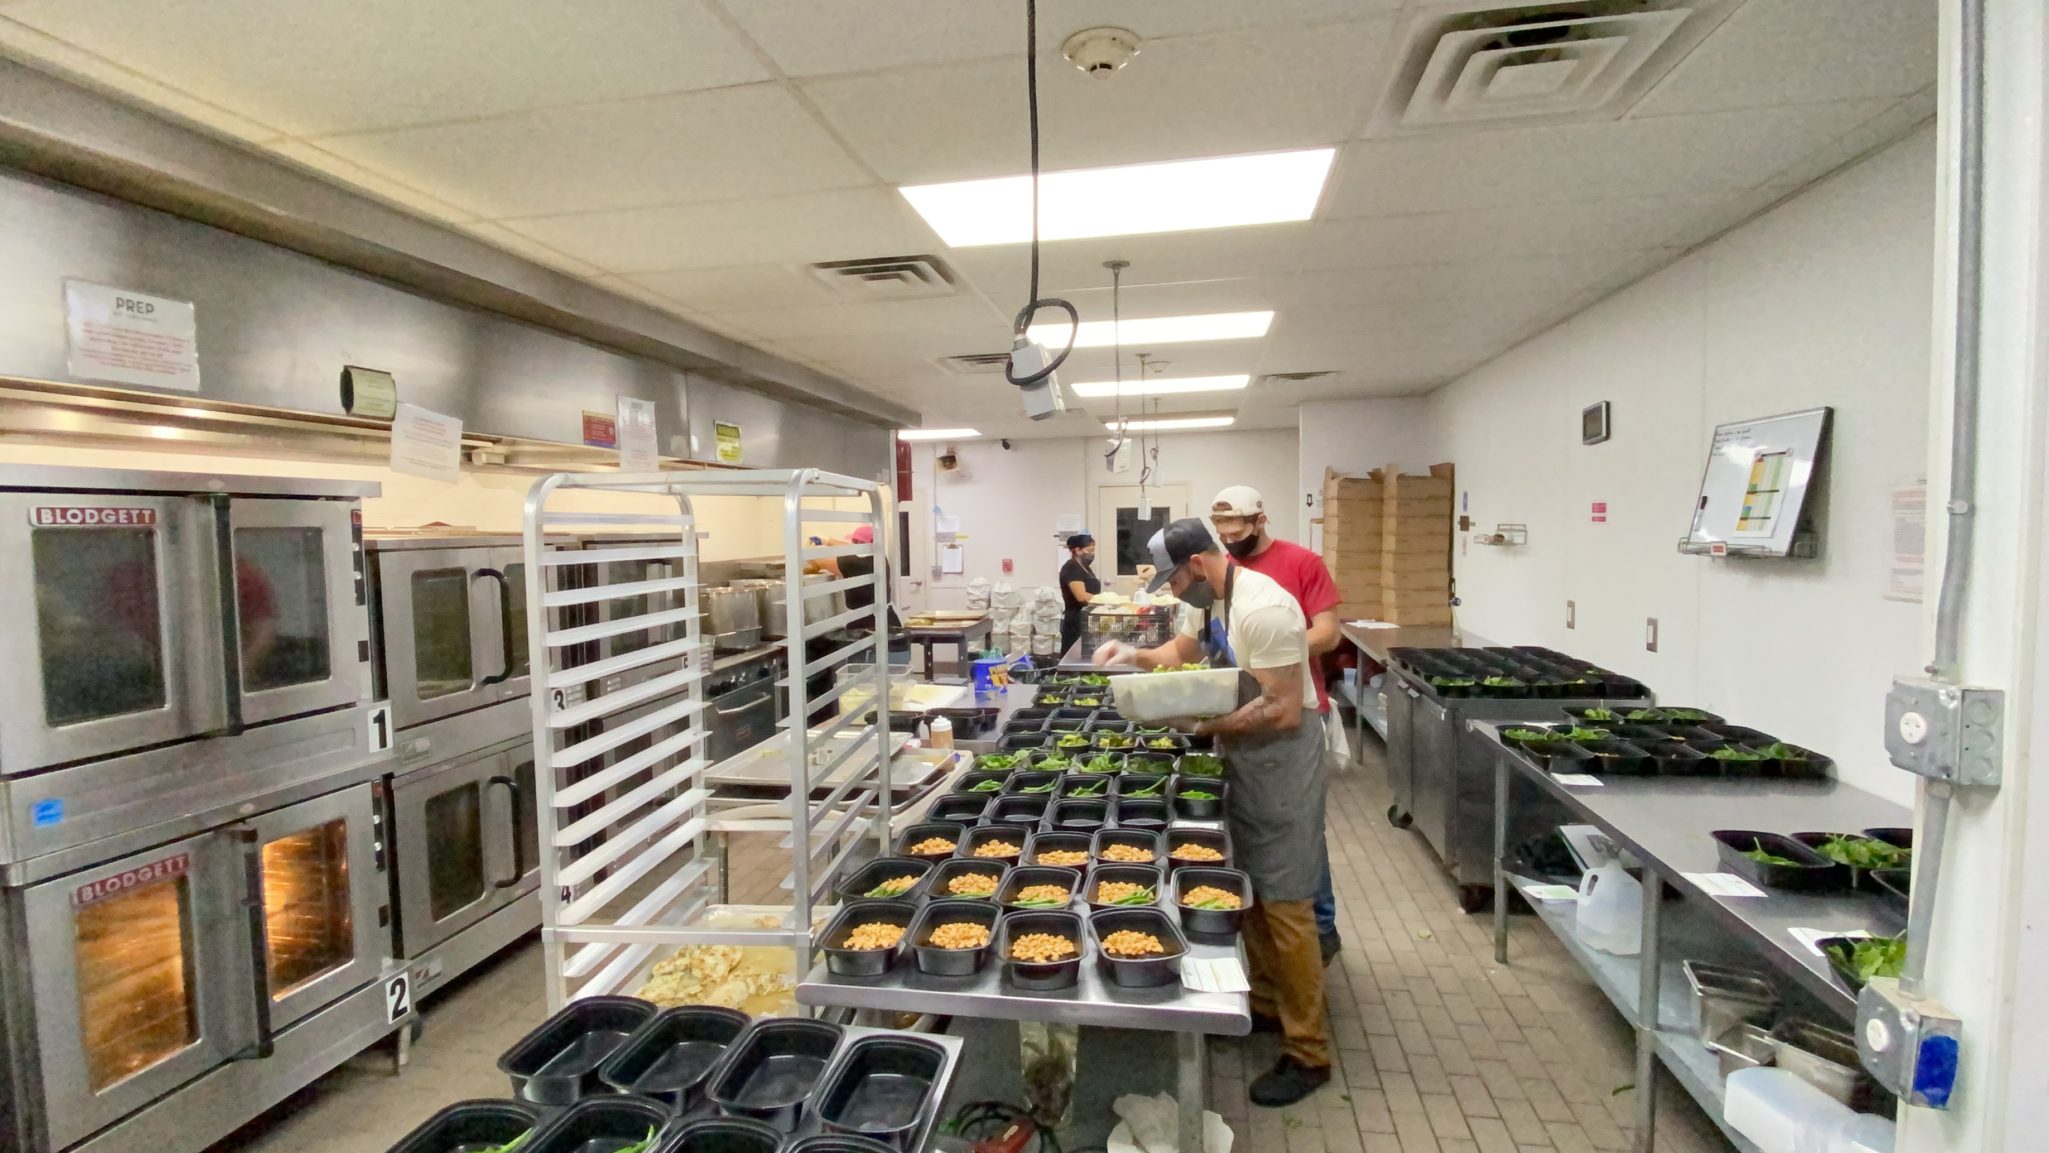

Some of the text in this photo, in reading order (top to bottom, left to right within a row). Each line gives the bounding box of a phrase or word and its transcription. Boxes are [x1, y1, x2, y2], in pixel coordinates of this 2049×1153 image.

[115, 297, 155, 315] PREP
[40, 508, 152, 524] BLODGETT
[373, 709, 387, 749] 1
[81, 857, 186, 902] BLODGETT
[561, 885, 571, 904] 4
[390, 978, 408, 1021] 2
